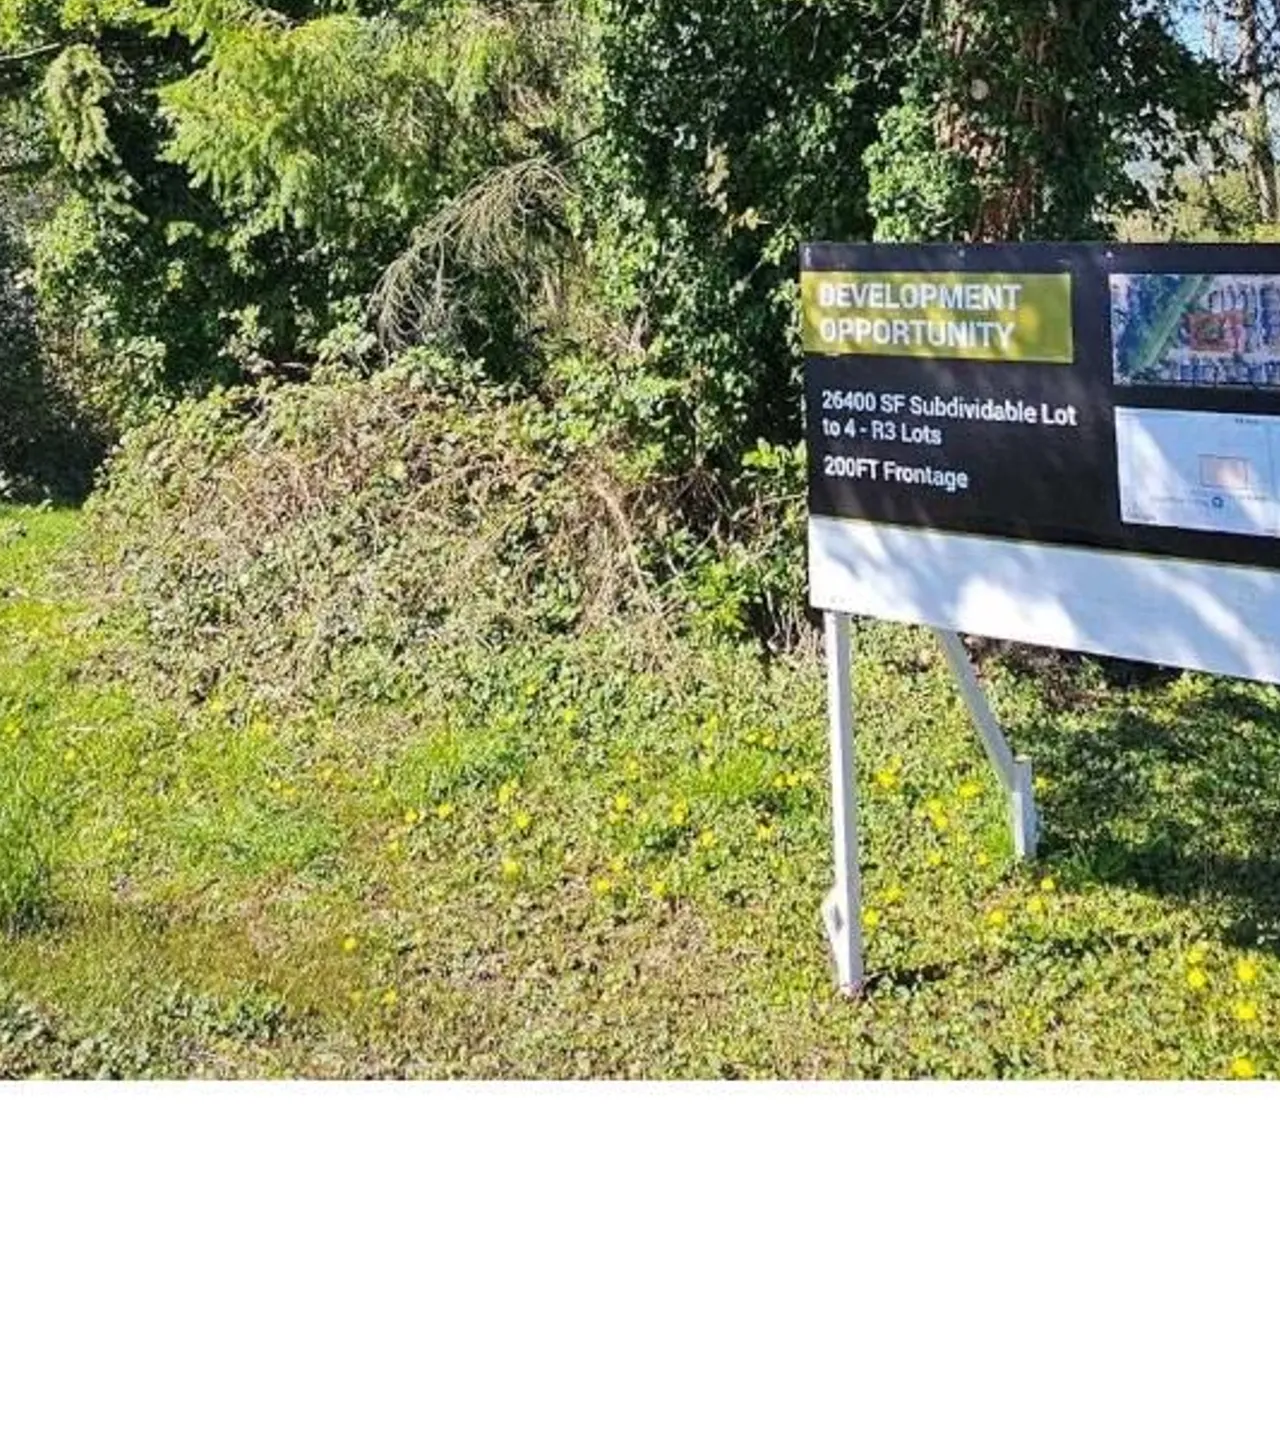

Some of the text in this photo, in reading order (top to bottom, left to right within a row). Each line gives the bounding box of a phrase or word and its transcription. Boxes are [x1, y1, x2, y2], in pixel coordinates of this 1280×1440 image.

[819, 282, 1022, 310] DEVELOPMENT
[821, 317, 1016, 349] OPPORTUNITY
[822, 390, 1078, 426] 26400 SF Subdividable Lot
[822, 417, 841, 437] to
[844, 418, 856, 437] 4
[872, 420, 897, 440] R3
[901, 424, 942, 445] Lots
[824, 456, 969, 492] 200FT Frontage
